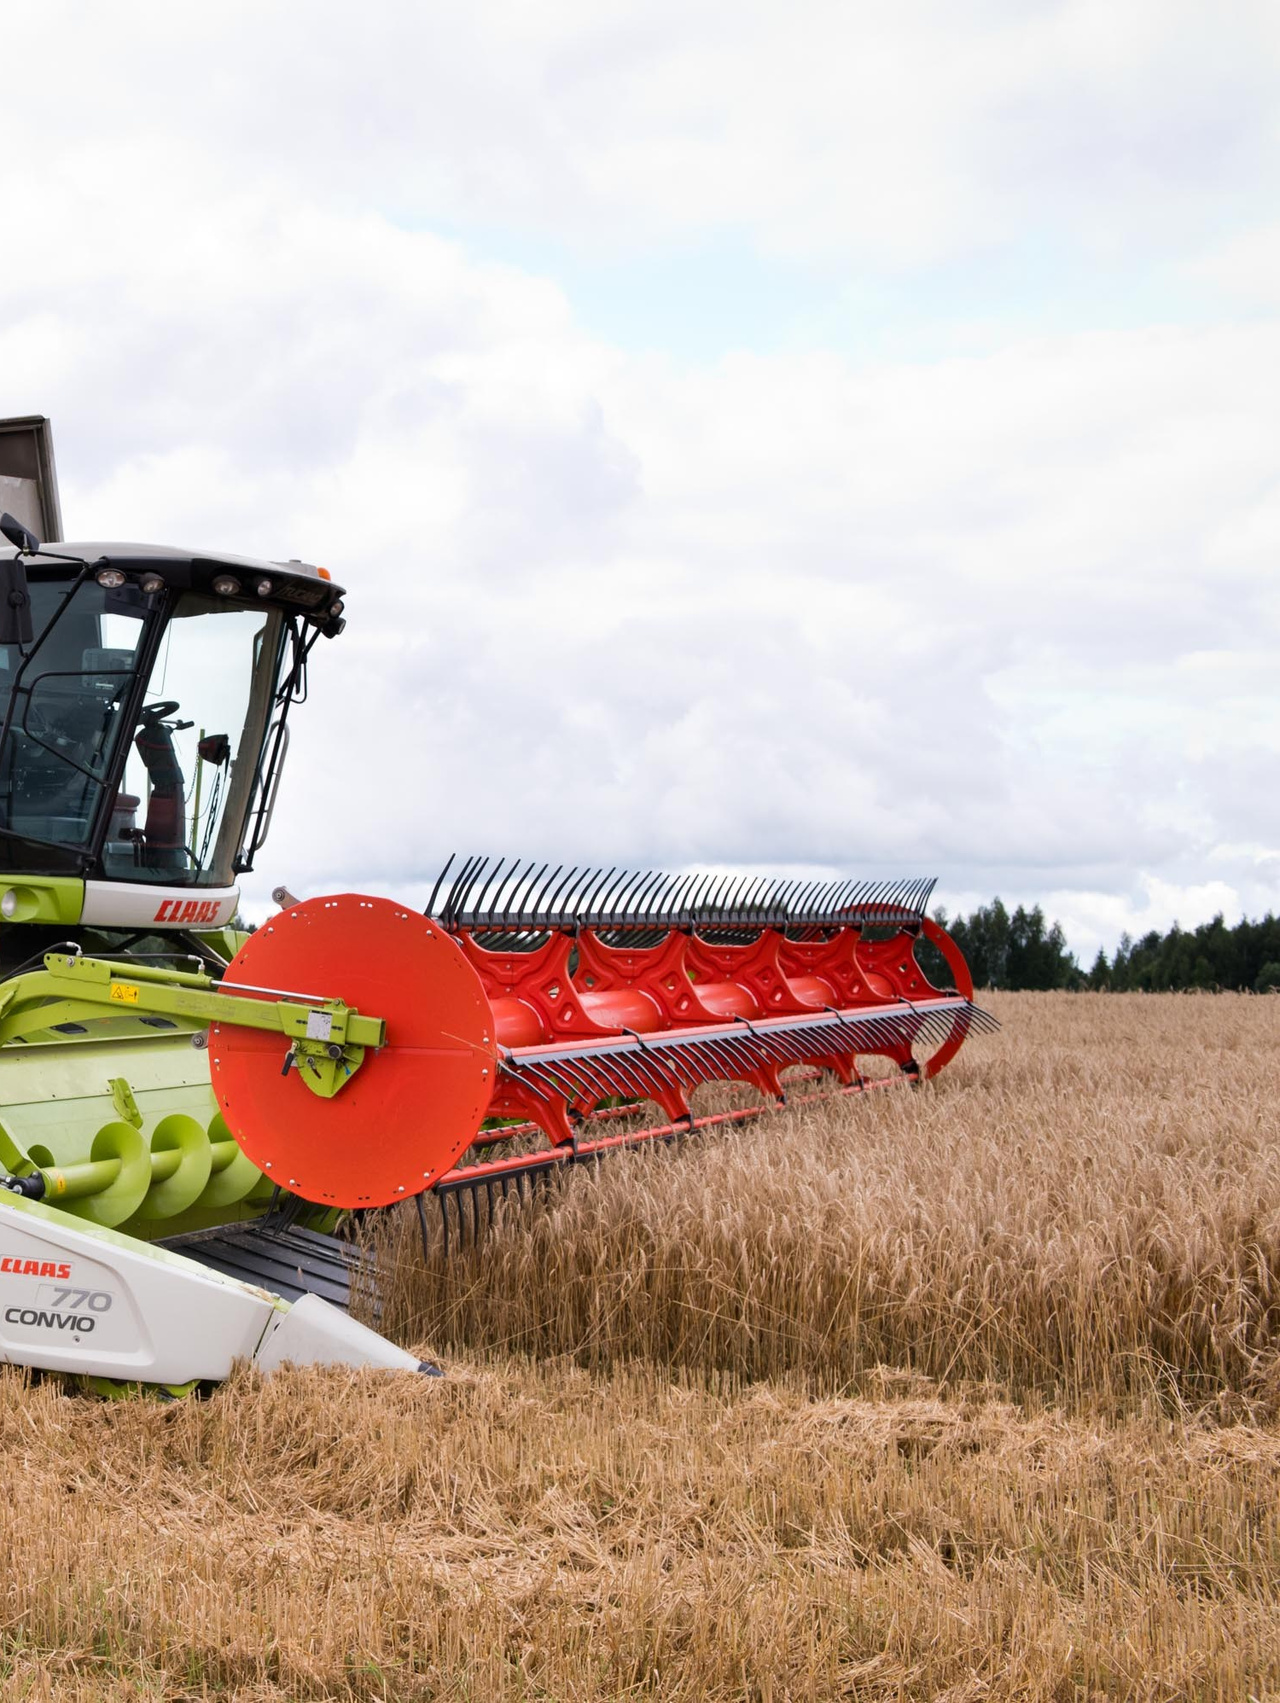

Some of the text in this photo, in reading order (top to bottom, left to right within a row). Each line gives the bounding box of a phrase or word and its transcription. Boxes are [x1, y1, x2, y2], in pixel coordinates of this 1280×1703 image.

[153, 900, 222, 922] CLAAS
[0, 1258, 71, 1279] CLAAS
[51, 1287, 112, 1312] 770
[5, 1308, 95, 1332] CONVIO
